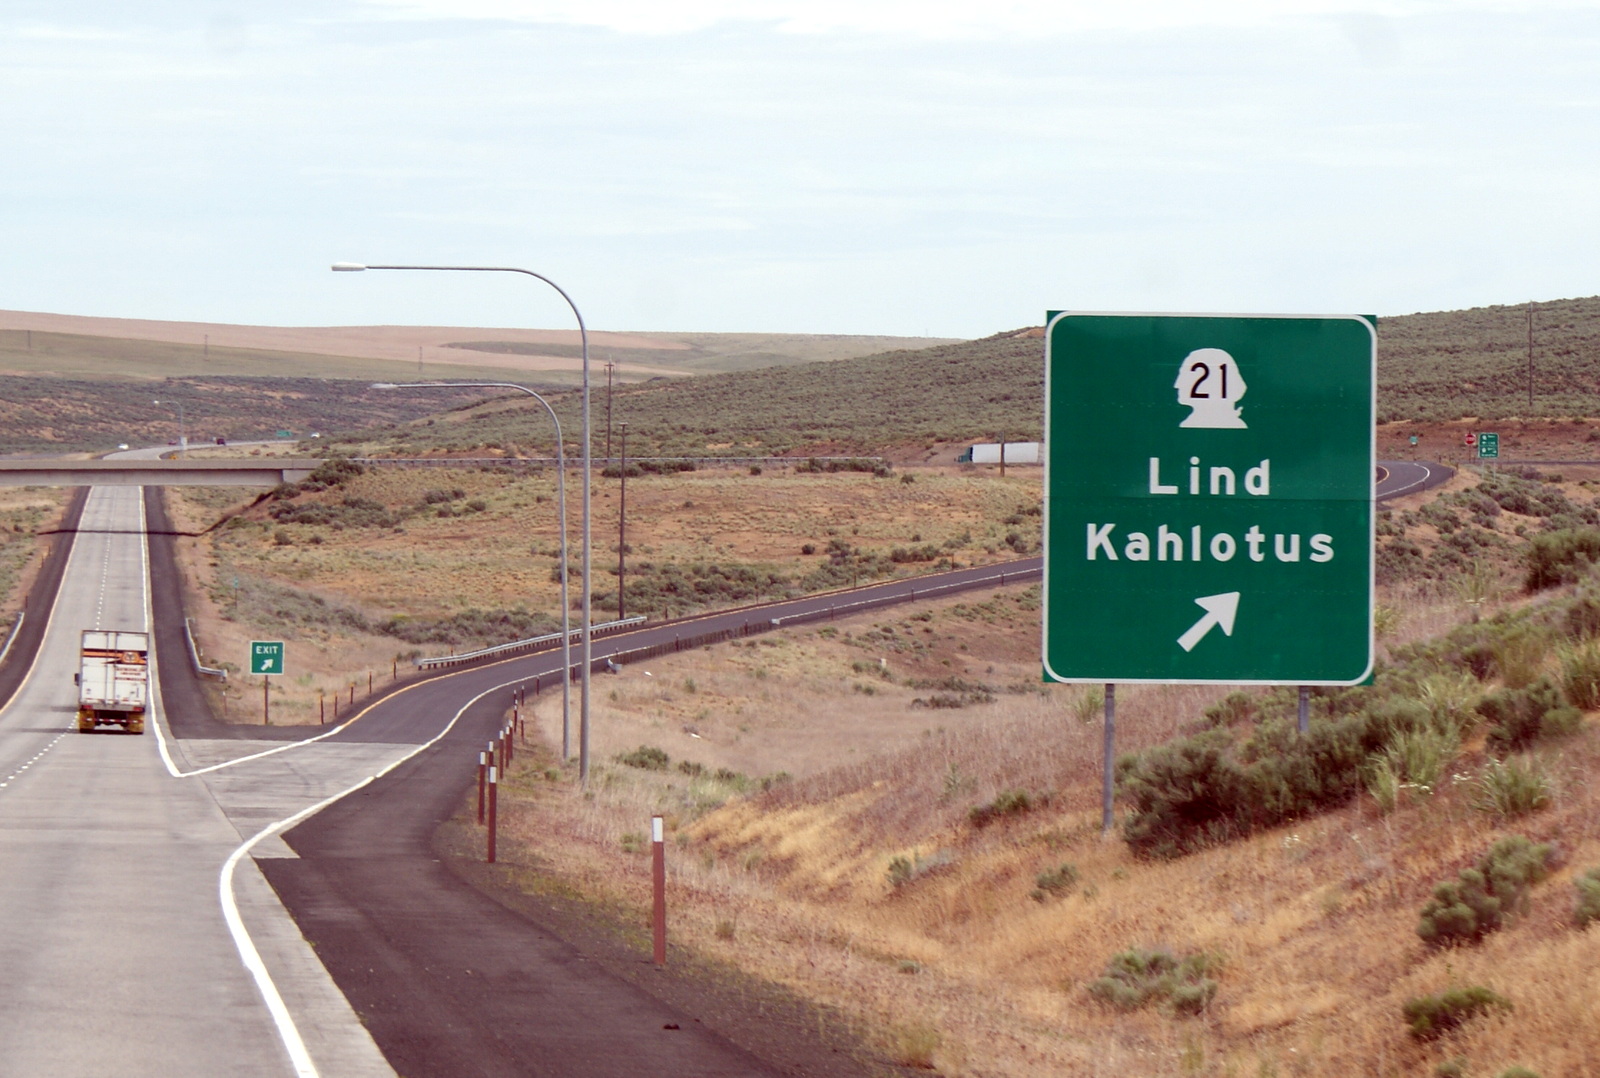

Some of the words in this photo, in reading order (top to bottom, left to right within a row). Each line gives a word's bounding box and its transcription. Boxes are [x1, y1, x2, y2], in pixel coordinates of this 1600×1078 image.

[1190, 362, 1227, 399] 21
[1149, 456, 1270, 495] Lind
[1086, 523, 1335, 563] Kahlotus
[255, 645, 279, 654] EXIT
